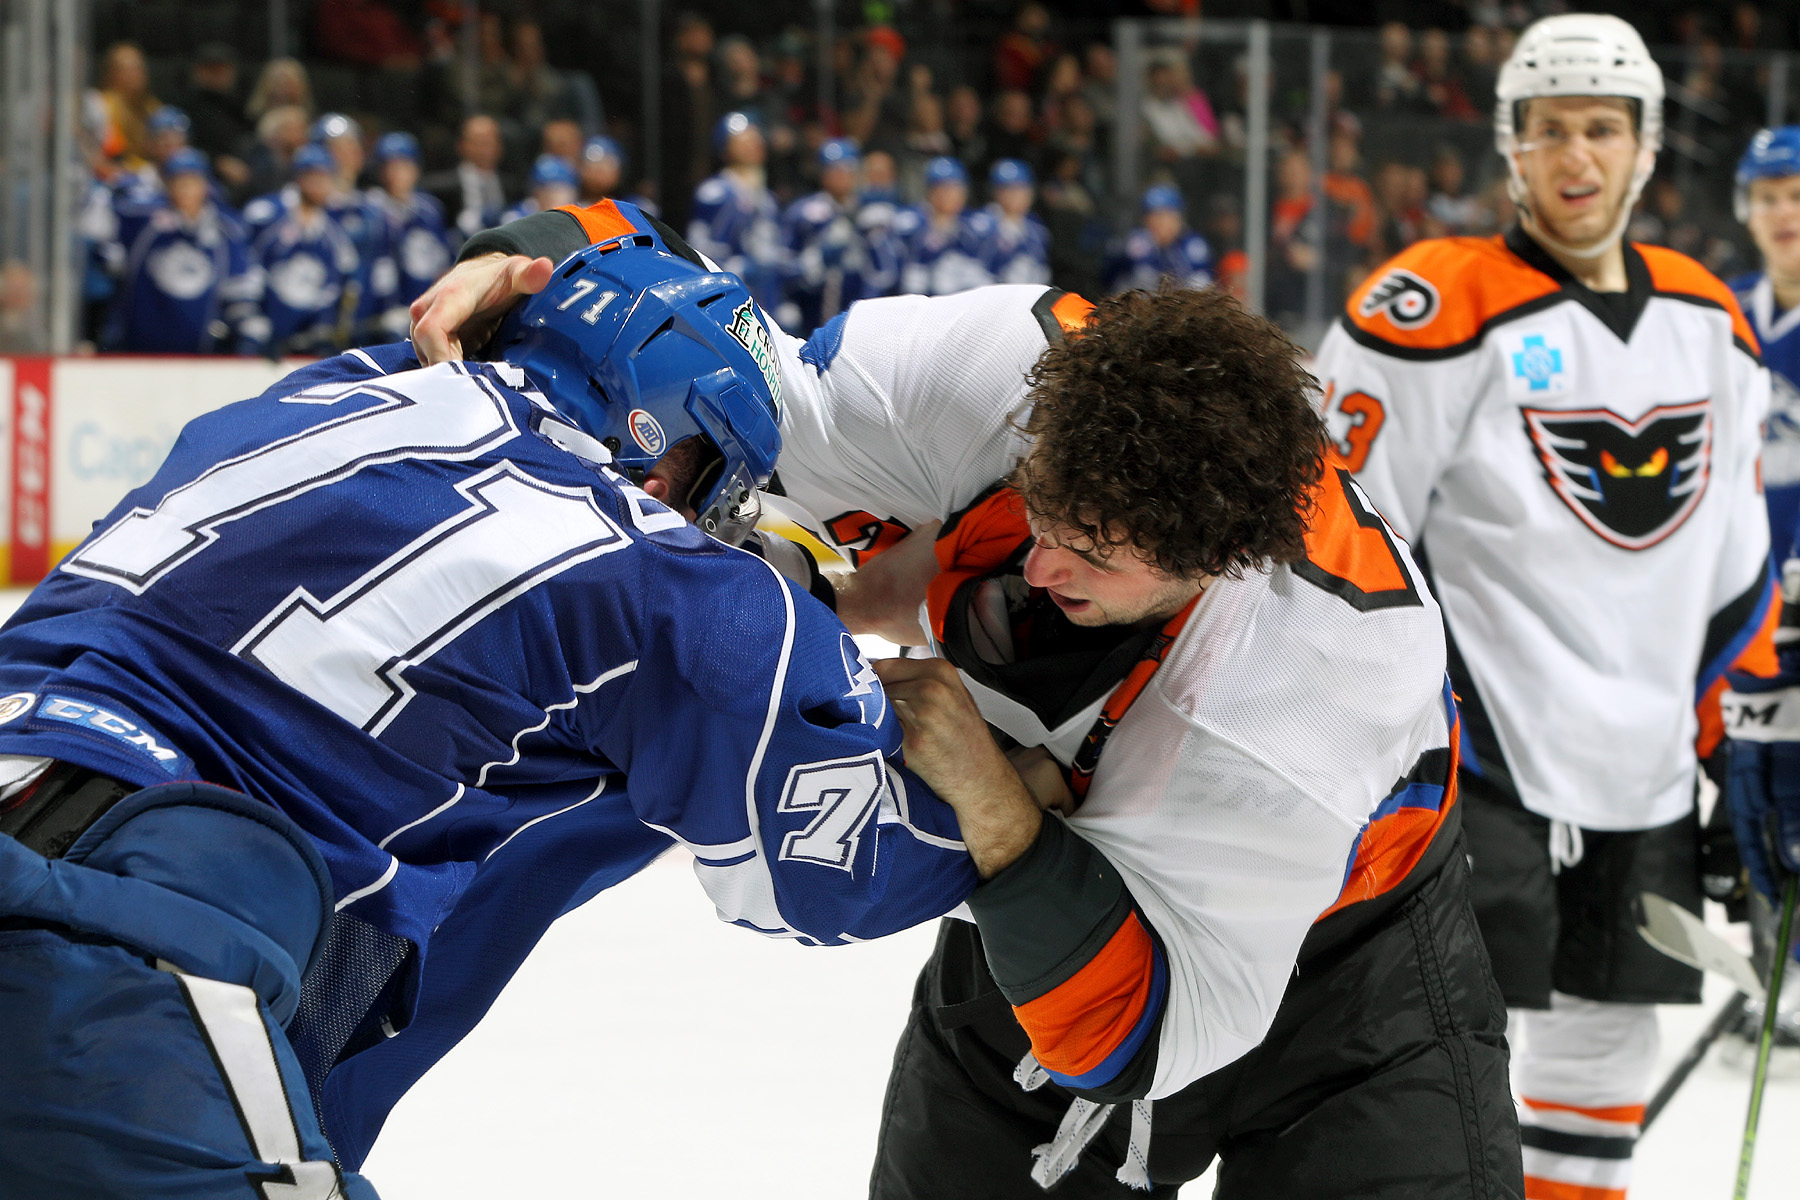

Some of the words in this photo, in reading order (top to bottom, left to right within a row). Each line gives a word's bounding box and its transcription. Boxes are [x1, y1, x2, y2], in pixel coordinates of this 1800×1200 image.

[556, 279, 617, 327] 71
[634, 421, 661, 449] AHL
[60, 358, 635, 740] 71
[45, 698, 178, 761] CCM
